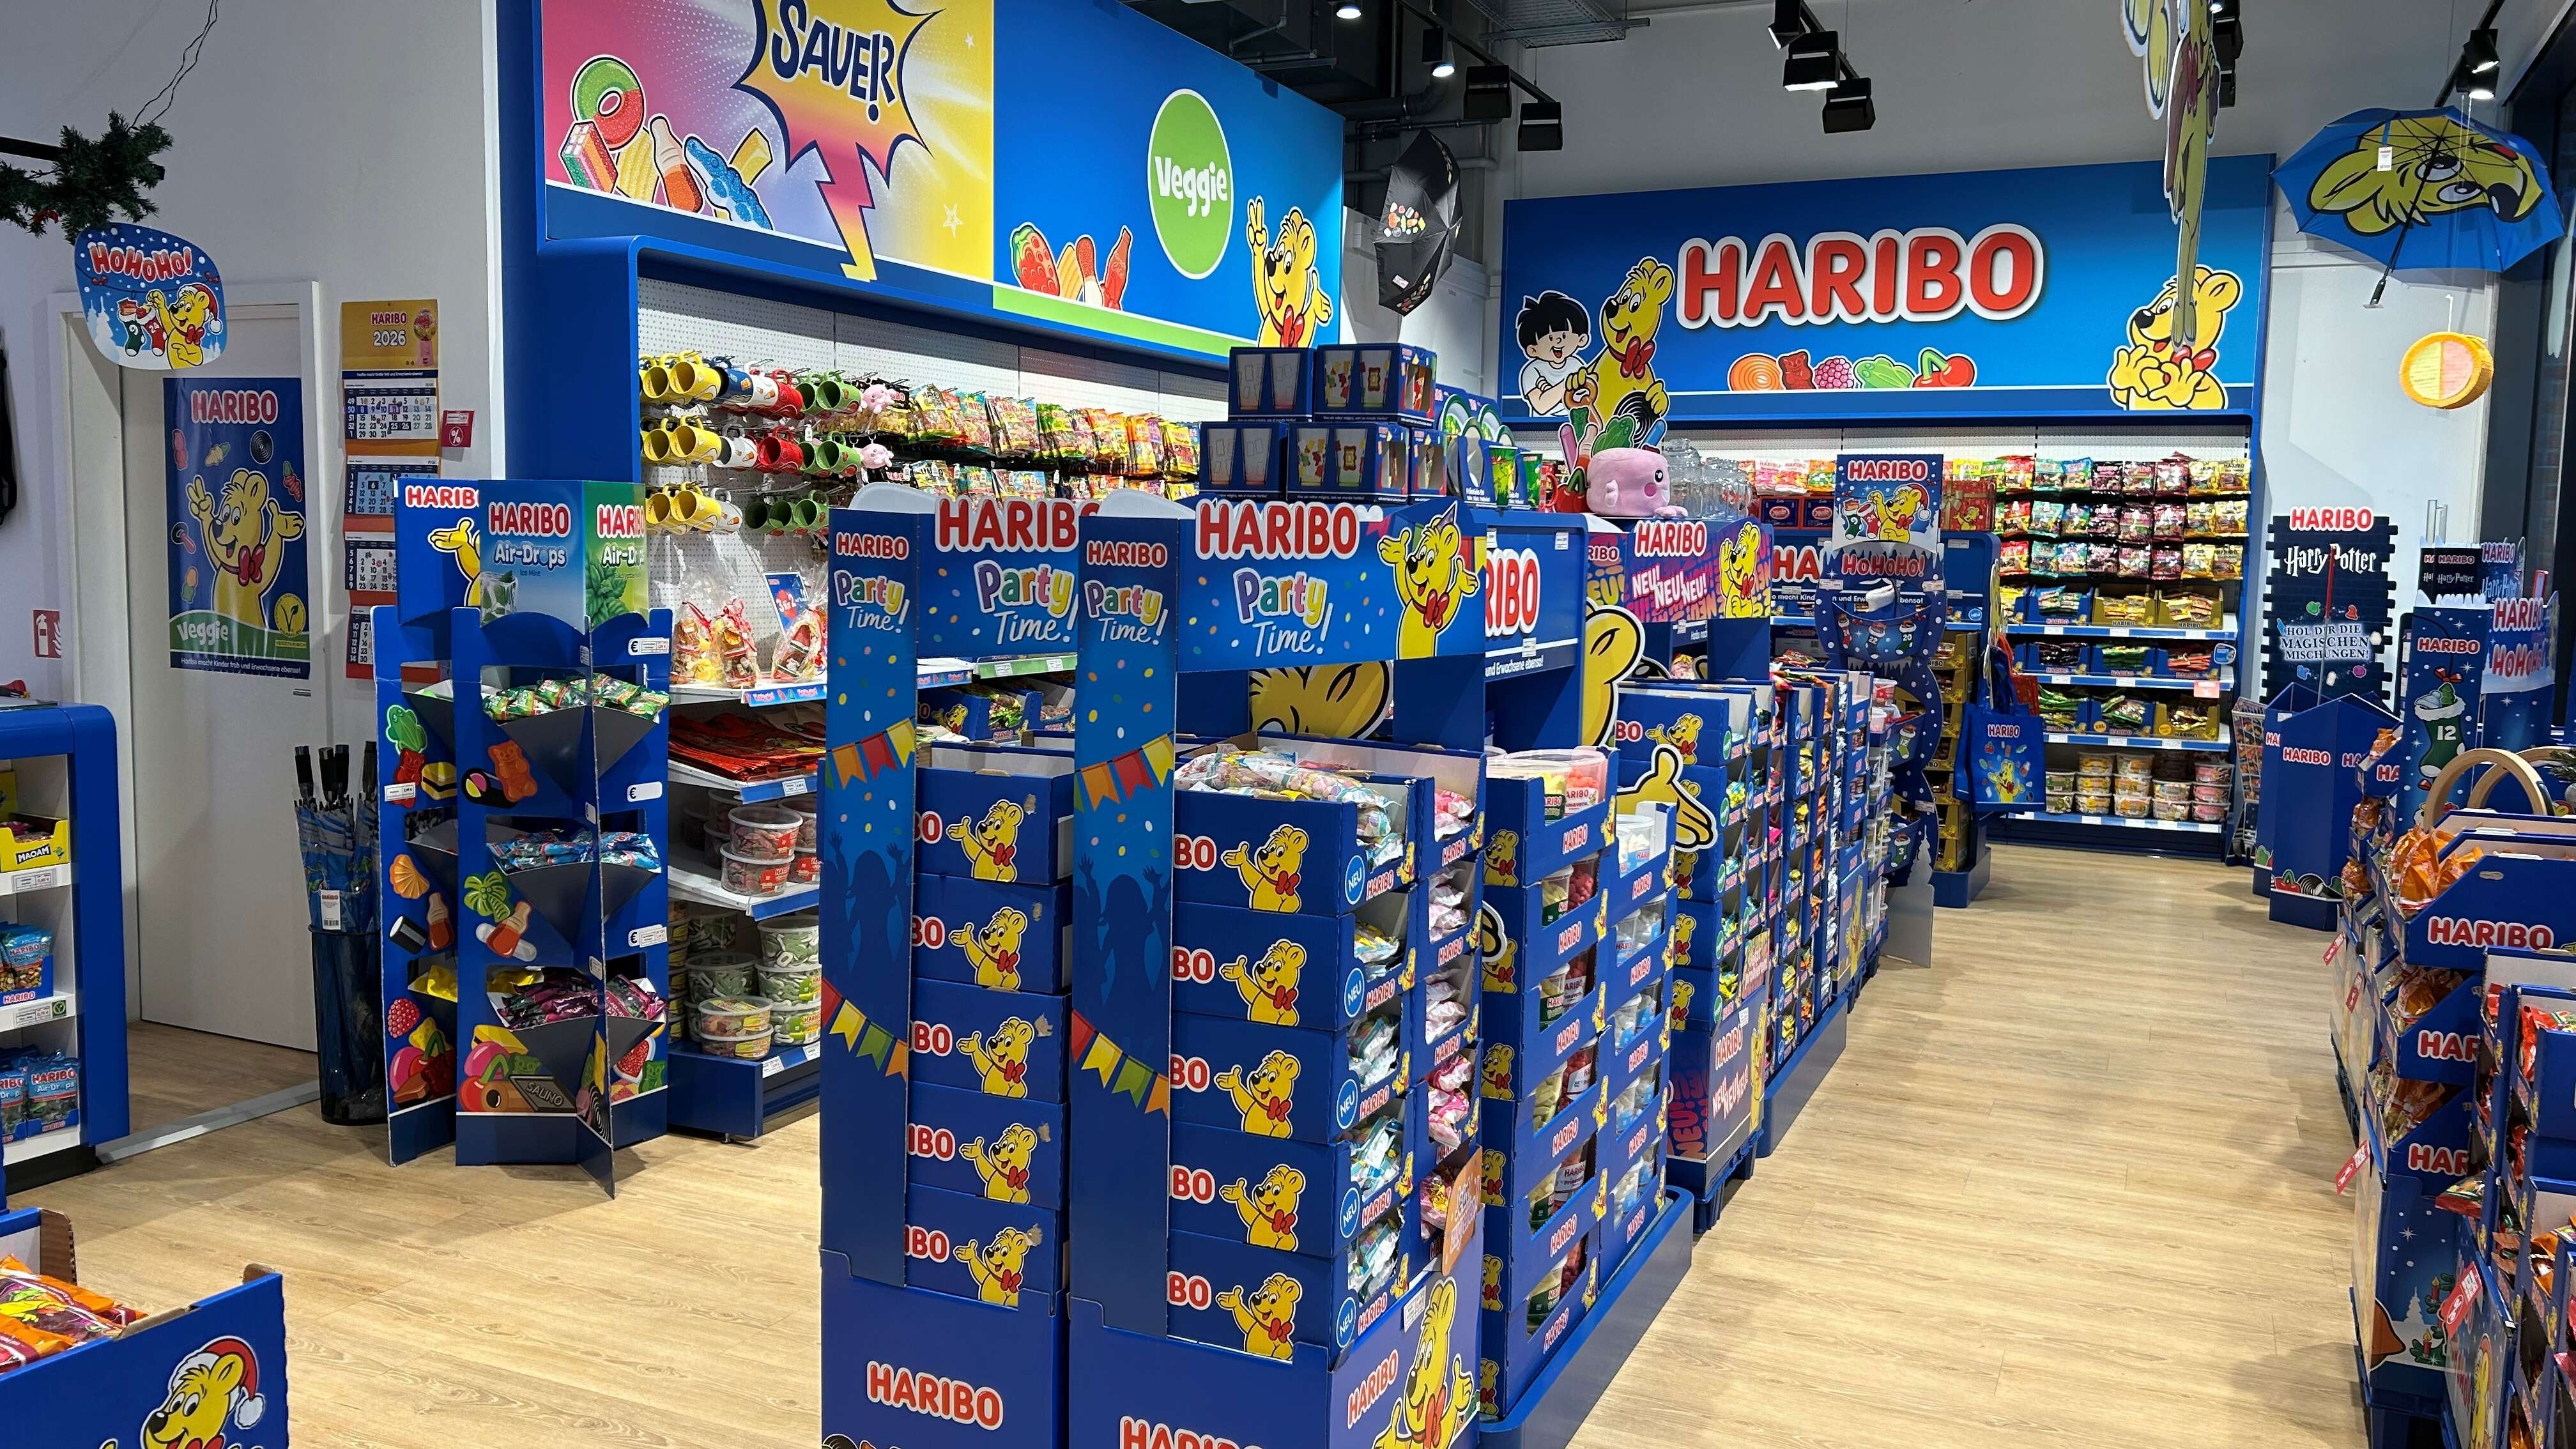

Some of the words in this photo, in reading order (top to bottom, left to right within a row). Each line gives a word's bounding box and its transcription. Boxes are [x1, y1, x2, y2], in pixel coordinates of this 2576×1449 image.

[1154, 156, 1228, 217] Veggie
[1678, 222, 2044, 329] HARIBO
[371, 312, 407, 325] HARIBO
[372, 330, 406, 346] 2026
[192, 390, 278, 424] HARIBO
[1848, 460, 1928, 481] HARIBO
[489, 502, 571, 537] HARIBO
[935, 495, 1100, 553] HARIB
[1195, 500, 1359, 560] HARIBO
[2290, 506, 2373, 532] HARIBO
[836, 532, 909, 560] HARIBO
[1086, 541, 1167, 568] HARIBO
[1588, 545, 1619, 562] RIBO
[1634, 520, 1708, 557] HARIBO
[2482, 542, 2515, 564] HARIBO
[2285, 545, 2328, 577] Harry
[2329, 543, 2377, 574] Potter
[2439, 555, 2474, 564] HARIBO
[834, 569, 905, 615] Party
[974, 560, 1075, 618] Party
[1485, 548, 1540, 637] RIBO
[1632, 564, 1660, 599] NEU!
[1654, 571, 1684, 609] NEU!
[1683, 573, 1708, 604] NEU!
[2437, 574, 2455, 584] Harry
[2455, 572, 2474, 583] Potter
[1084, 579, 1164, 626] Party
[1233, 567, 1328, 629] Party
[2493, 597, 2543, 632] HARIBO
[177, 620, 228, 645] Veggie
[847, 599, 910, 633] Time!
[993, 595, 1078, 645] Time!
[1097, 608, 1168, 645] Time!
[1252, 603, 1333, 657] Time!
[2287, 627, 2310, 636] HOL
[2315, 626, 2336, 635] DIR
[2340, 624, 2361, 634] DIE
[2282, 637, 2368, 648] MAGISCHEN
[2286, 649, 2369, 660] MISCHUNGEN!
[2418, 637, 2480, 655] HARIBO
[1485, 663, 1495, 677] und
[1496, 658, 1524, 675] Erwachsene
[1525, 654, 1544, 671] ebenso!
[1988, 724, 2020, 739] HARIBO
[2437, 725, 2457, 741] 12
[2283, 746, 2331, 766] HARIBO
[17, 845, 49, 863] MAOAM
[1442, 838, 1466, 866] HARIBO
[1563, 823, 1588, 855] HARIBO
[1348, 866, 1363, 888] NEU
[1367, 869, 1394, 901] HARIBO
[1632, 871, 1652, 900] HARIBO
[10, 944, 40, 955] HARIBO
[1558, 921, 1582, 955] HARIBO
[2428, 916, 2554, 950] HARIBO
[1438, 937, 1463, 966] HARIBO
[1630, 956, 1651, 986] HARIBO
[3, 992, 35, 1003] HARIBO
[1347, 979, 1362, 1002] NEU
[1365, 978, 1395, 1012] HARIBO
[1434, 1033, 1460, 1066] HARIBO
[1556, 1018, 1580, 1056] HARIBO
[1715, 1023, 1743, 1071] HARIBO
[2418, 1030, 2480, 1062] HAR
[1629, 1040, 1649, 1073] HARIBO
[0, 1078, 25, 1089] RIBO
[31, 1068, 76, 1085] HARIBO
[526, 1080, 564, 1107] SALINO
[1340, 1091, 1355, 1114] NEU
[1359, 1085, 1390, 1121] HARIBO
[908, 1123, 955, 1162] IBO
[1552, 1117, 1579, 1158] HARIBO
[1629, 1124, 1647, 1159] HARIBO
[2409, 1142, 2468, 1176] HAR
[1343, 1206, 1358, 1226] NEU
[1361, 1187, 1392, 1229] HARIBO
[1627, 1206, 1645, 1243] HARIBO
[1550, 1214, 1577, 1257] HARIBO
[1340, 1314, 1354, 1333] NEU
[1358, 1292, 1387, 1333] HARIBO
[1544, 1307, 1569, 1354] HARIBO
[867, 1360, 1003, 1430] HARIBO
[1347, 1349, 1399, 1429] HARIBO
